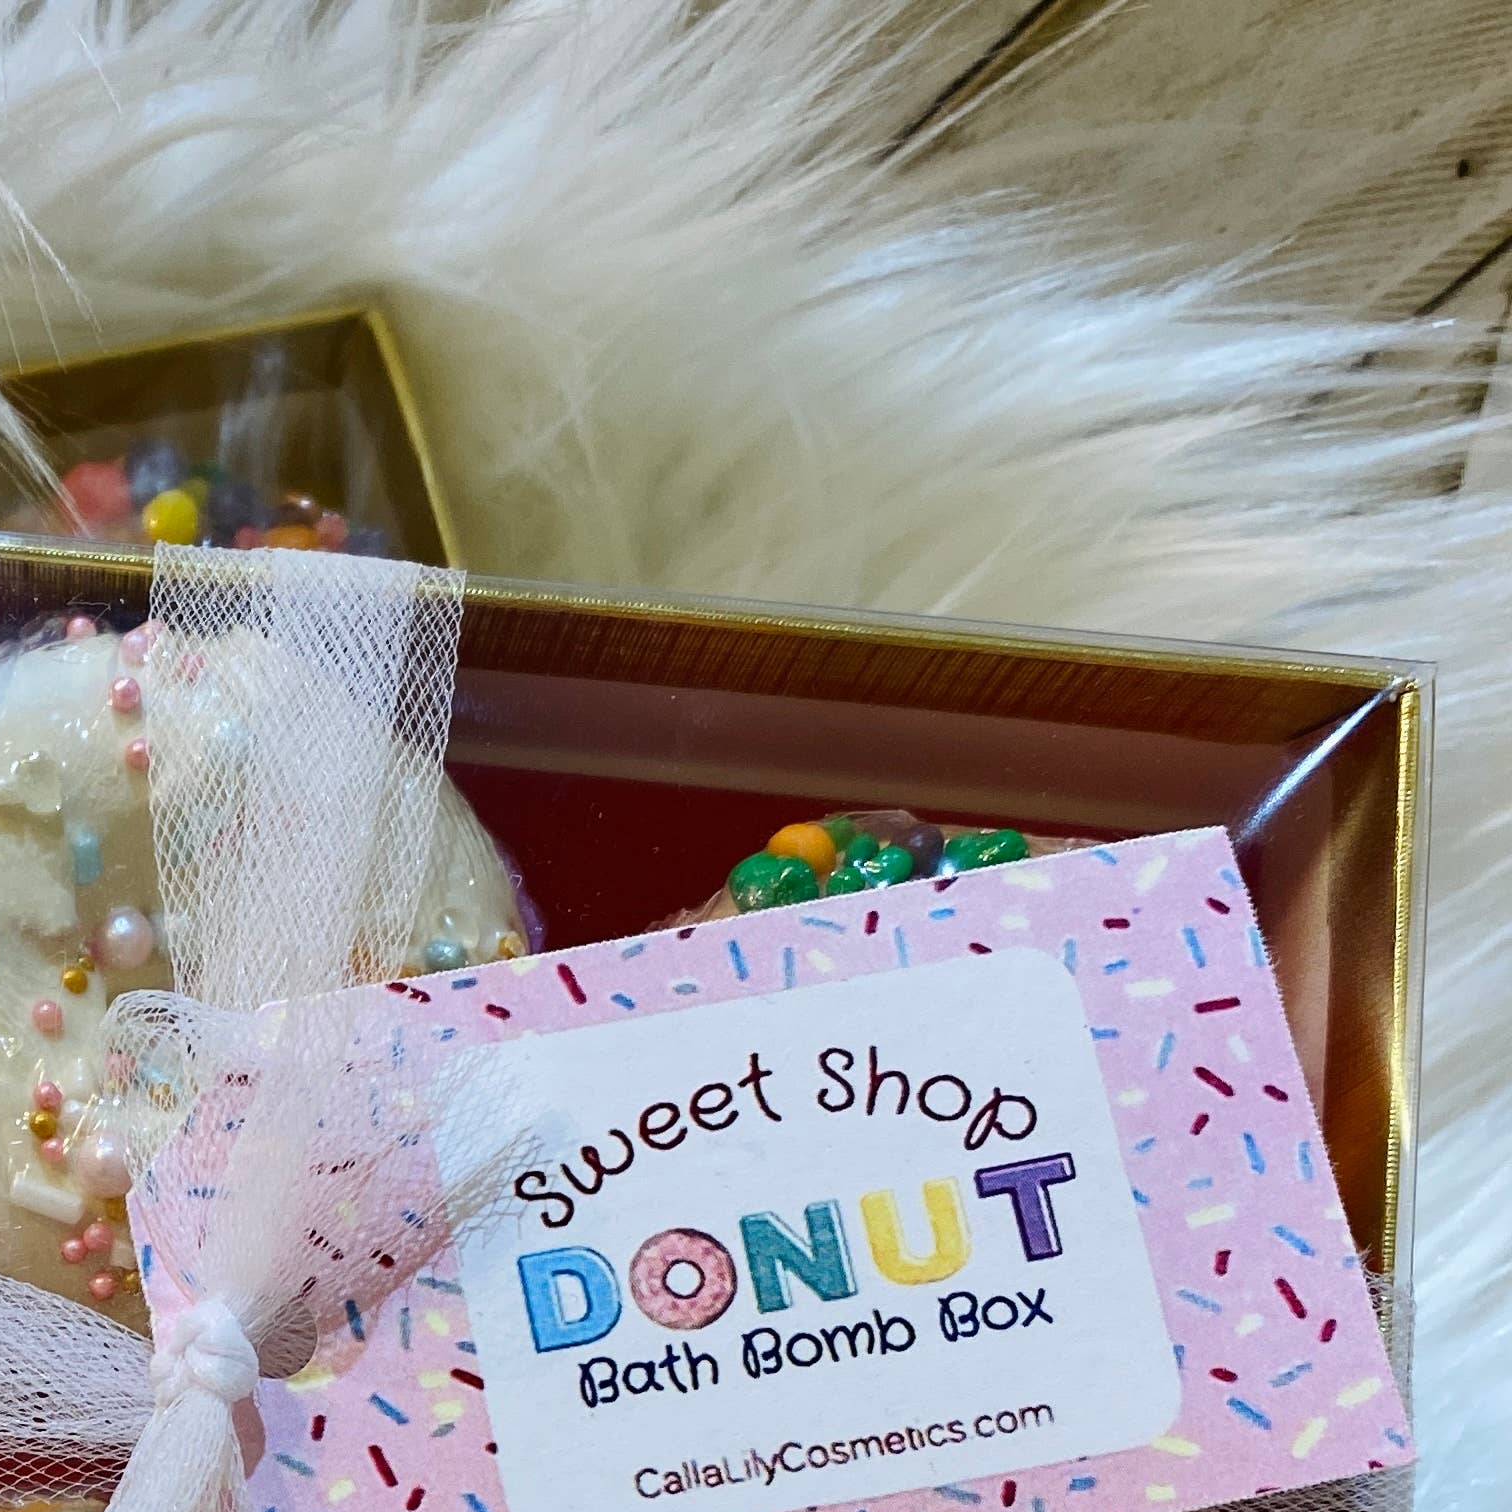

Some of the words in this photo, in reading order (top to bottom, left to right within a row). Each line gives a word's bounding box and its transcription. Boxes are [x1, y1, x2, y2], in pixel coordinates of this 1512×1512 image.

[515, 1053, 782, 1228] Sweet
[817, 1046, 1037, 1150] Shop
[517, 1153, 1076, 1353] DONUT
[579, 1343, 719, 1408] Bath
[741, 1309, 916, 1379] Bomb
[939, 1288, 1054, 1342] Box
[634, 1403, 1055, 1499] CallaLilyCosmetics.com
